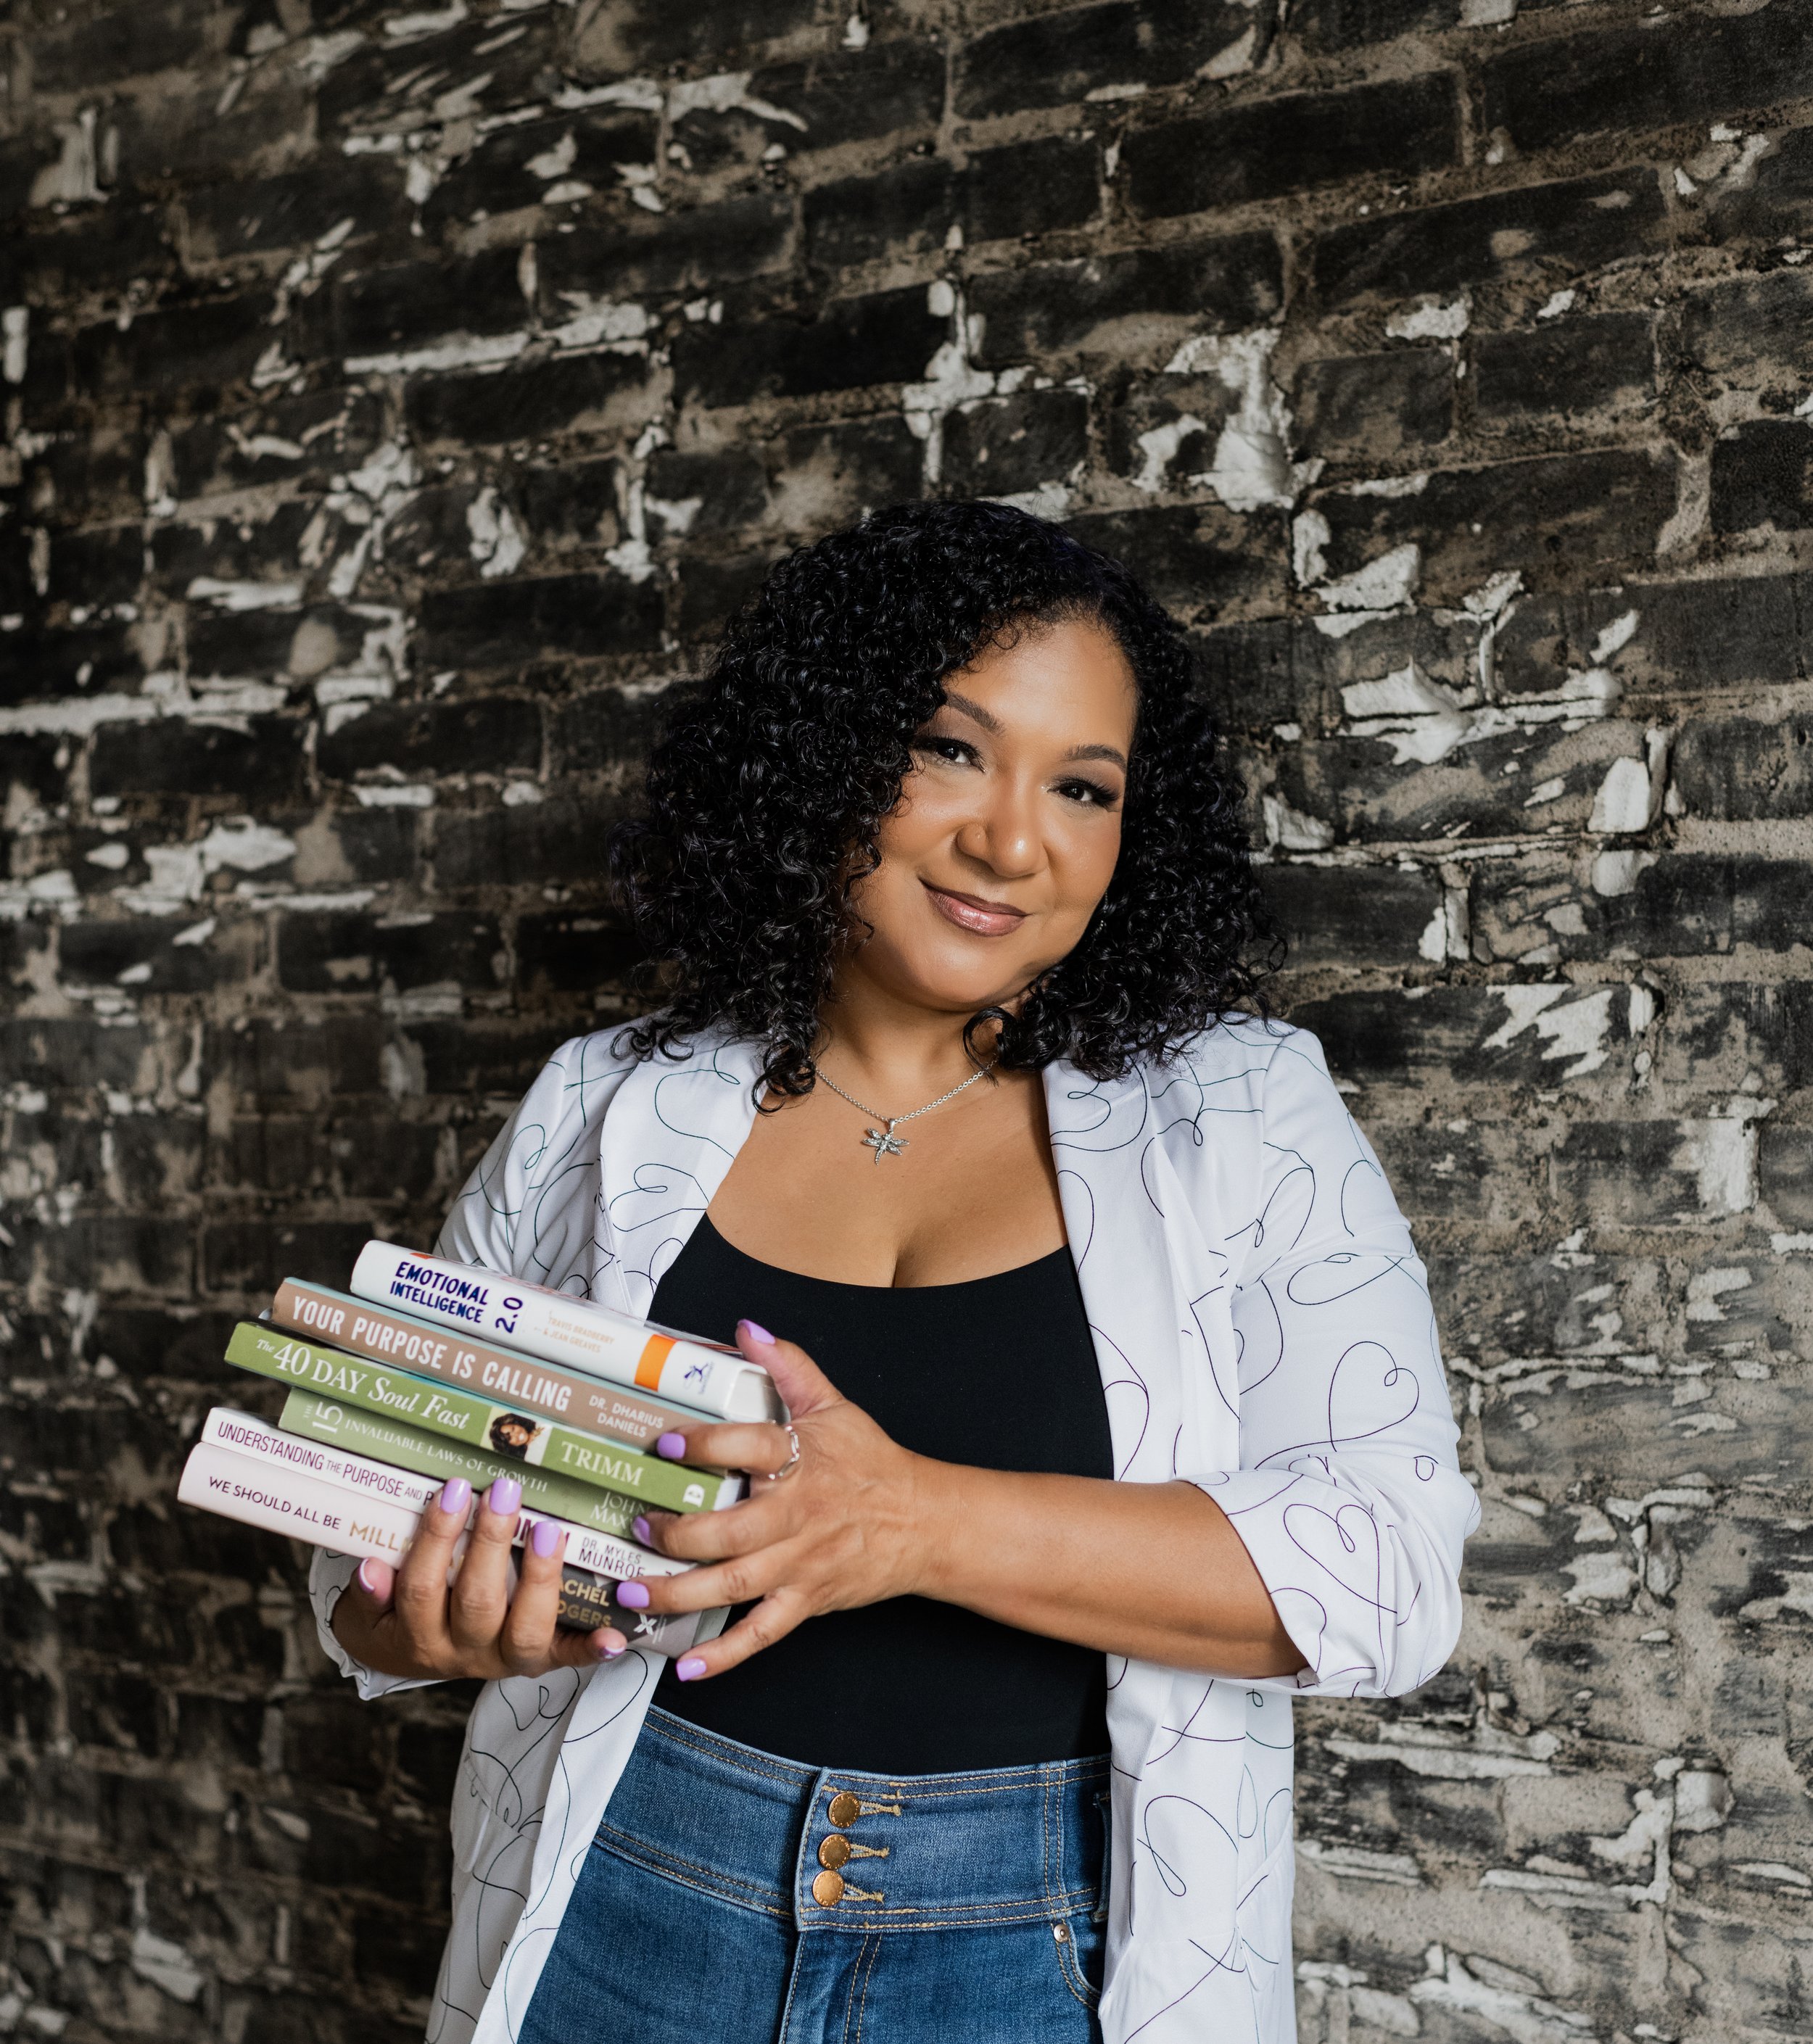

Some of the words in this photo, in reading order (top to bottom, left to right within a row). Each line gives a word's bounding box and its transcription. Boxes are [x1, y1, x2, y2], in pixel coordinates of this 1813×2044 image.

[390, 1281, 484, 1323] INTELLIGENCE
[395, 1262, 489, 1305] EMOTIONAL
[495, 1297, 523, 1333] 2.0
[293, 1296, 345, 1335] YOUR
[351, 1317, 447, 1370] PURPOSE
[452, 1351, 476, 1378] IS
[482, 1361, 571, 1411] CALLING
[569, 1336, 601, 1353] GREAVES
[256, 1338, 275, 1353] The
[273, 1343, 310, 1375] 40
[310, 1358, 368, 1394] DAY
[367, 1377, 421, 1412] Soul
[420, 1394, 470, 1430] Fast
[313, 1401, 343, 1433] 15
[589, 1395, 608, 1411] DR.
[612, 1402, 664, 1428] DHARIUS
[597, 1415, 647, 1438] DANIELS
[218, 1421, 324, 1470] UNDERSTANDING
[326, 1460, 342, 1473] THE
[342, 1464, 405, 1497] PURPOSE
[404, 1486, 422, 1500] AND
[345, 1419, 424, 1453] INVALUABLE
[426, 1444, 463, 1465] LAWS
[466, 1458, 485, 1471] OF
[487, 1465, 548, 1492] GROWTH
[561, 1441, 644, 1486] TRIMM
[210, 1476, 230, 1493] WE
[233, 1485, 291, 1513] SHOULD
[294, 1506, 318, 1523] ALL
[323, 1515, 342, 1530] BE
[606, 1545, 642, 1564] MYLES
[558, 1599, 612, 1628] OGERS
